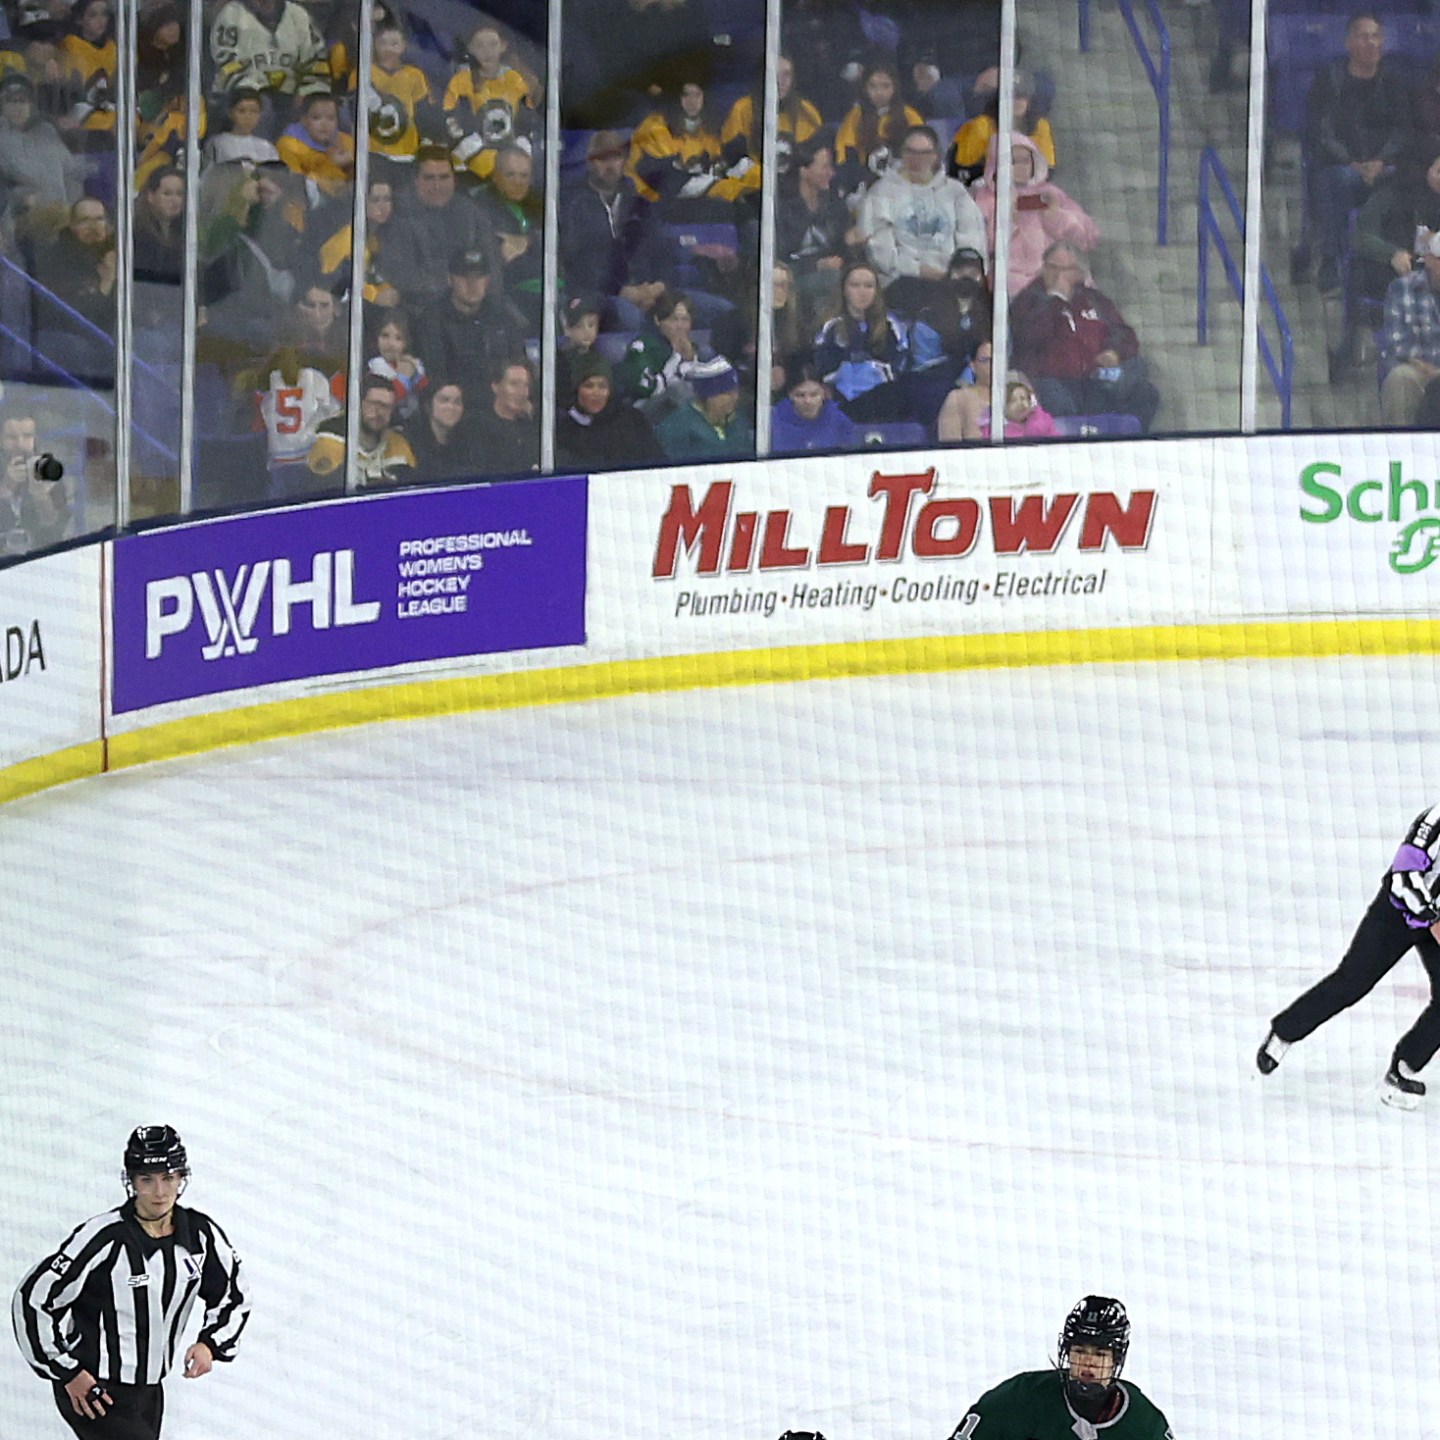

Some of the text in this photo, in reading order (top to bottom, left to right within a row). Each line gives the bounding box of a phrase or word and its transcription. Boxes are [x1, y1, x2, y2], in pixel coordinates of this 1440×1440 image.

[276, 387, 304, 434] 5
[1299, 460, 1440, 523] Sch
[399, 529, 533, 557] PROFESSIONAL
[398, 554, 483, 578] WOMEN'S
[397, 575, 471, 599] HOCKEY
[674, 568, 1107, 618] Plumbing Heating Cooling Electrical
[145, 549, 381, 661] PWHL
[397, 595, 468, 619] LEAGUE
[50, 1254, 72, 1275] 64
[127, 1274, 151, 1287] SP
